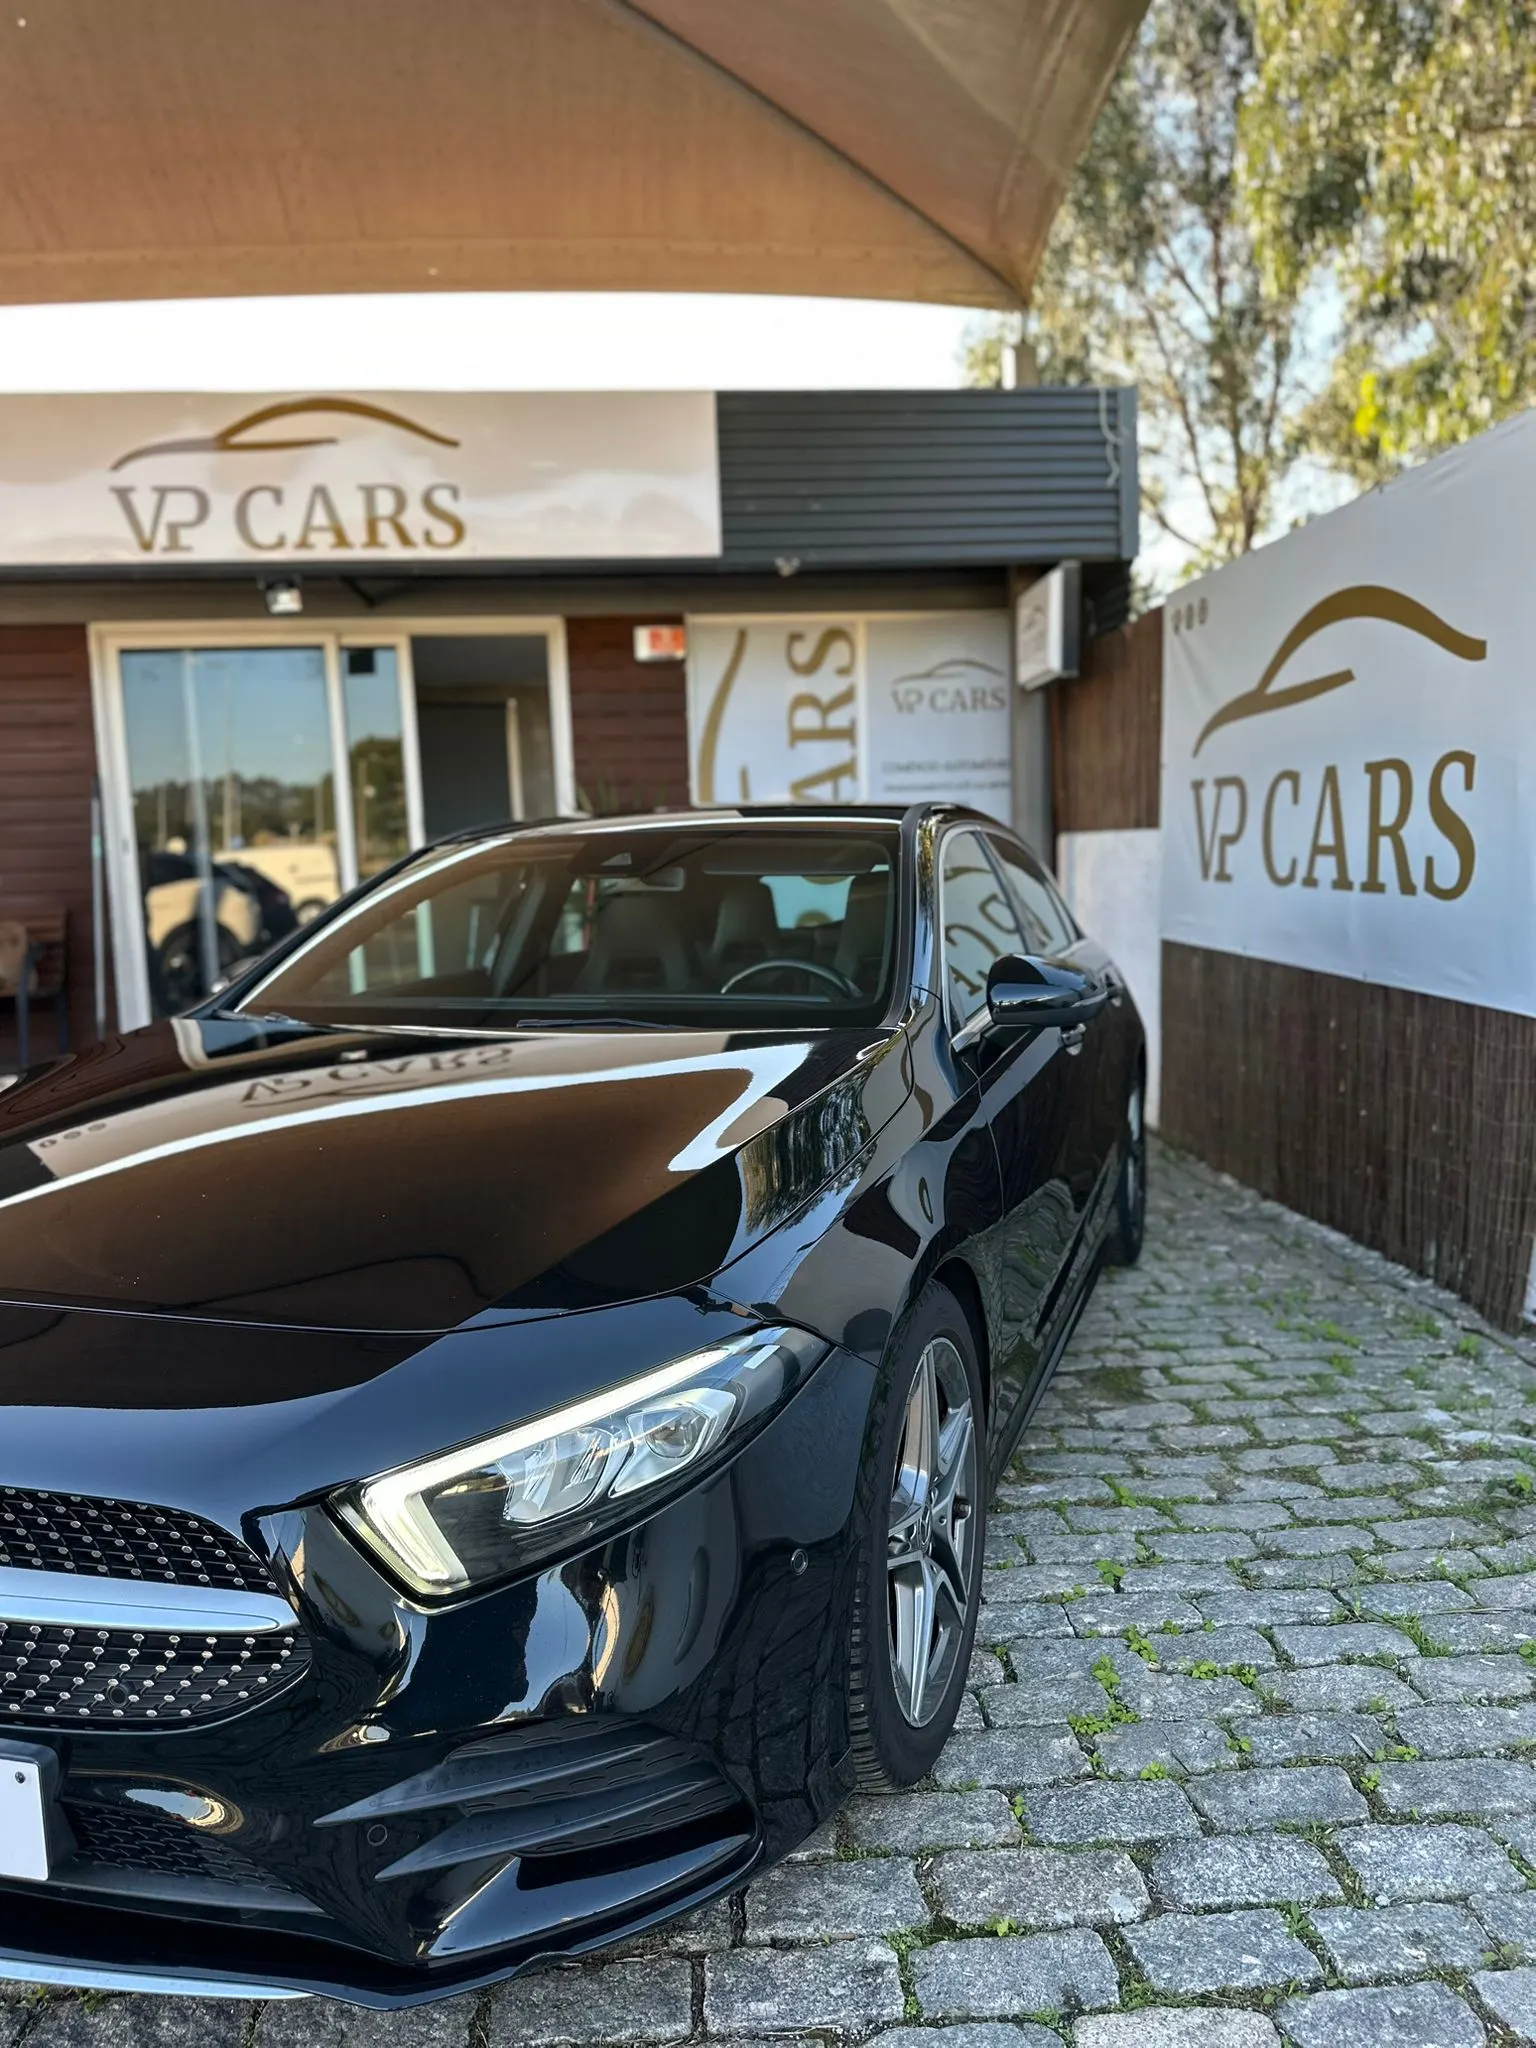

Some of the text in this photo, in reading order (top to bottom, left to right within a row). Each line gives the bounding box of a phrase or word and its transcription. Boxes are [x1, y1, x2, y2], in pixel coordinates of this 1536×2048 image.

[108, 482, 467, 552] VP CARS
[890, 685, 1007, 714] VP CARS
[1190, 749, 1476, 901] VP CARS
